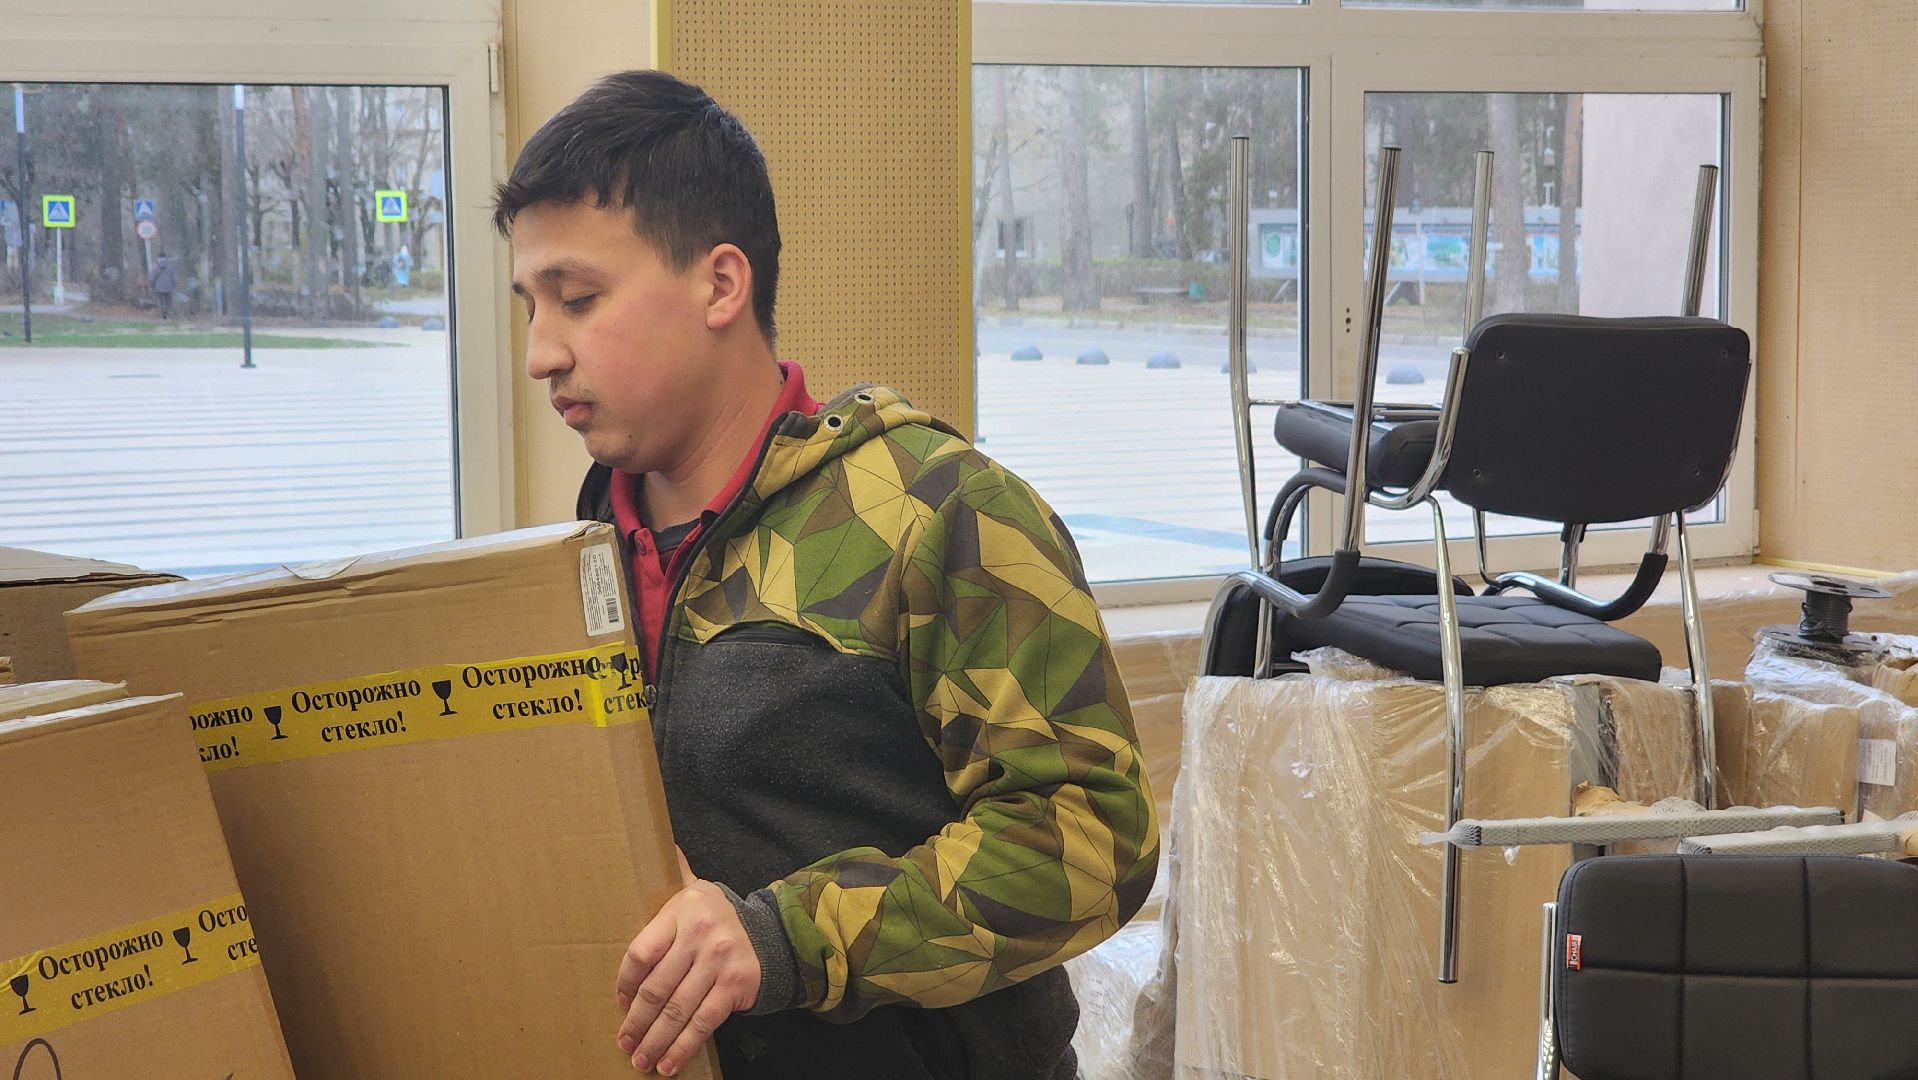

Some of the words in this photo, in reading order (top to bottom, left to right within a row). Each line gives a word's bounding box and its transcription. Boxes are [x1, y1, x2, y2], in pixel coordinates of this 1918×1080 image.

[291, 680, 421, 713] Осторожно
[462, 656, 600, 688] Осторожно
[492, 688, 583, 719] стекло!
[321, 710, 407, 742] стекло!
[38, 930, 164, 980] Осторожно
[70, 964, 154, 1010] стекло!
